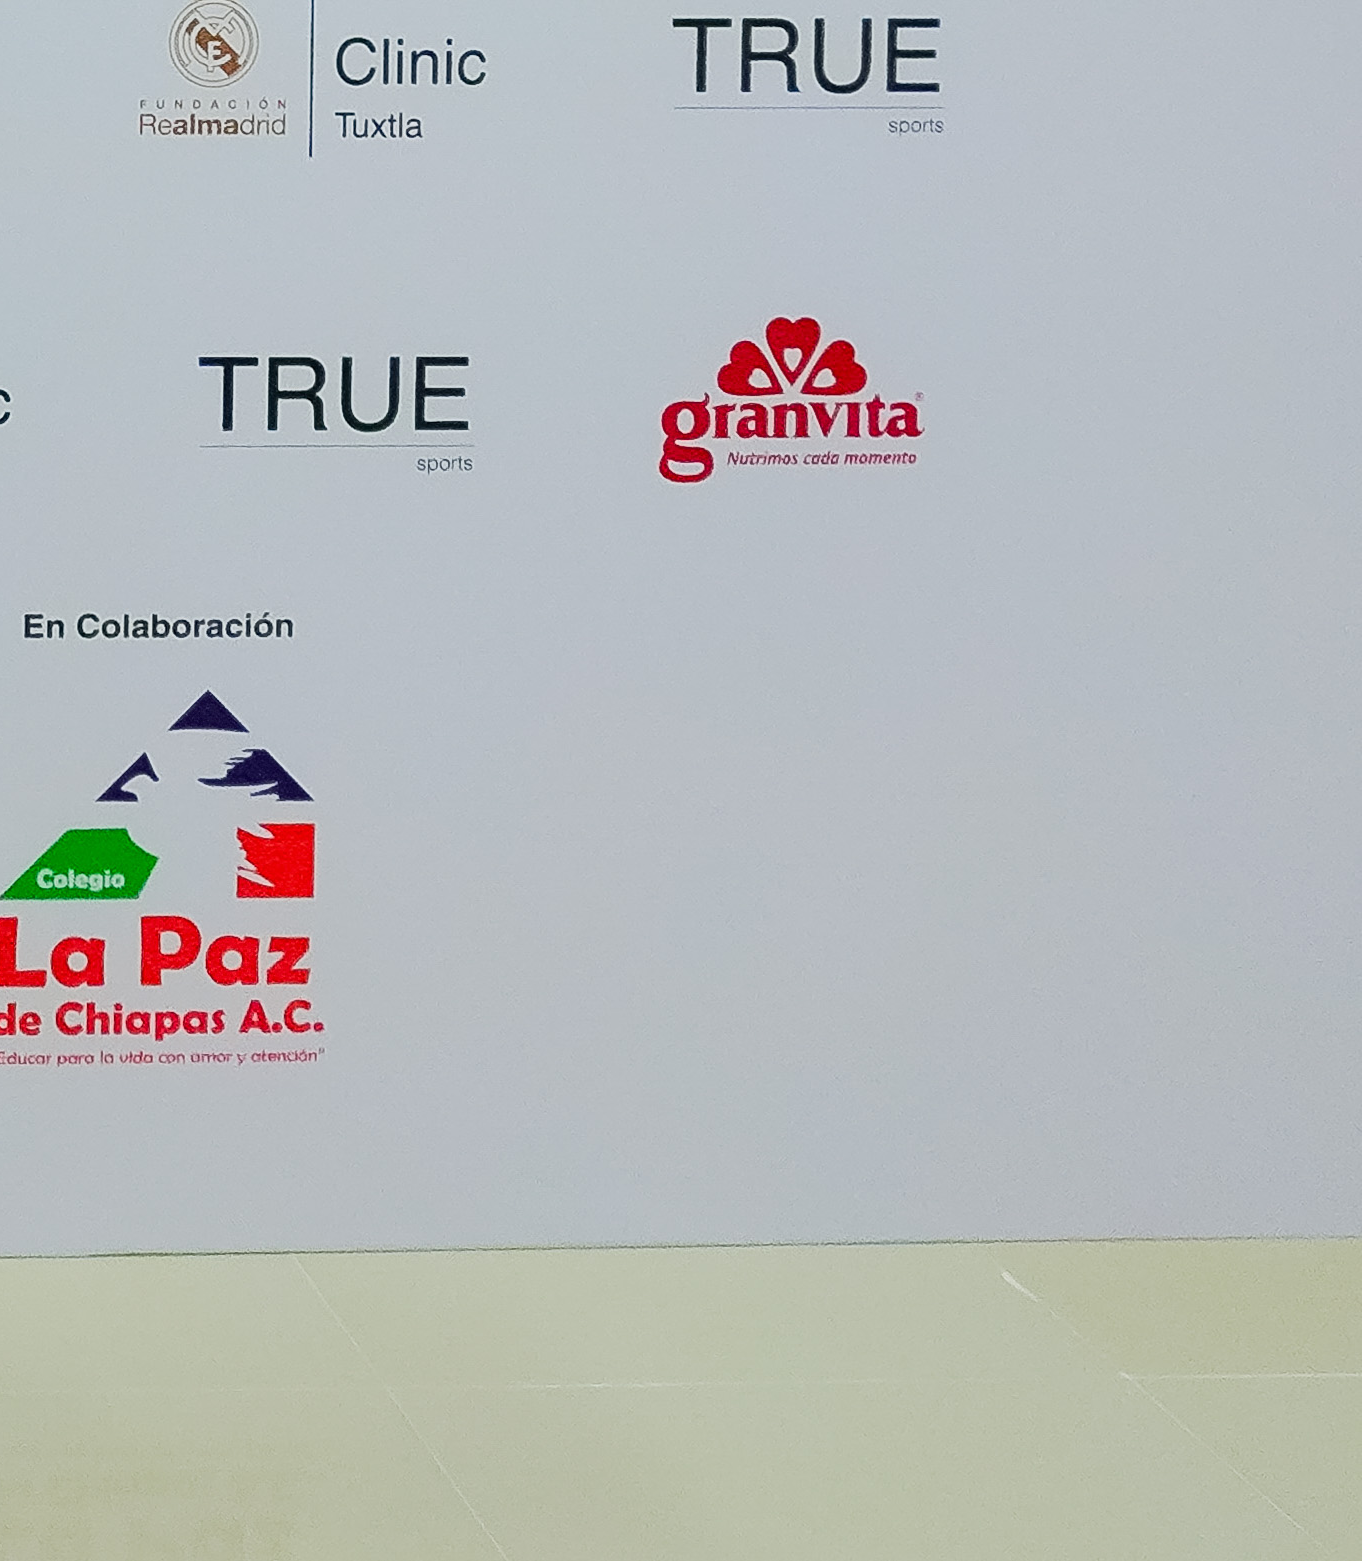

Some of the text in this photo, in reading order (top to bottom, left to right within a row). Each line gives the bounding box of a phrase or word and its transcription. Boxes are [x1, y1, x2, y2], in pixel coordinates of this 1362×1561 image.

[337, 38, 485, 86] Clinic
[673, 18, 940, 94] TRUE
[140, 97, 286, 109] FUNDACIÓN
[140, 114, 285, 135] Realmadrid
[335, 112, 422, 138] Tuxtla
[889, 119, 943, 135] sports
[199, 357, 469, 432] TRUE
[659, 392, 924, 484] granvita
[417, 456, 472, 474] sports
[727, 451, 916, 465] Nutrimos cada momento
[24, 612, 293, 638] En Colaboración
[35, 868, 125, 892] Colegio
[140, 916, 310, 986] Paz
[56, 1002, 225, 1041] Chiapas
[239, 1000, 324, 1033] A.C.
[56, 1052, 94, 1067] para
[101, 1051, 114, 1063] la
[120, 1051, 153, 1064] vida
[159, 1053, 185, 1064] con
[191, 1053, 233, 1063] amor
[237, 1052, 247, 1067] y
